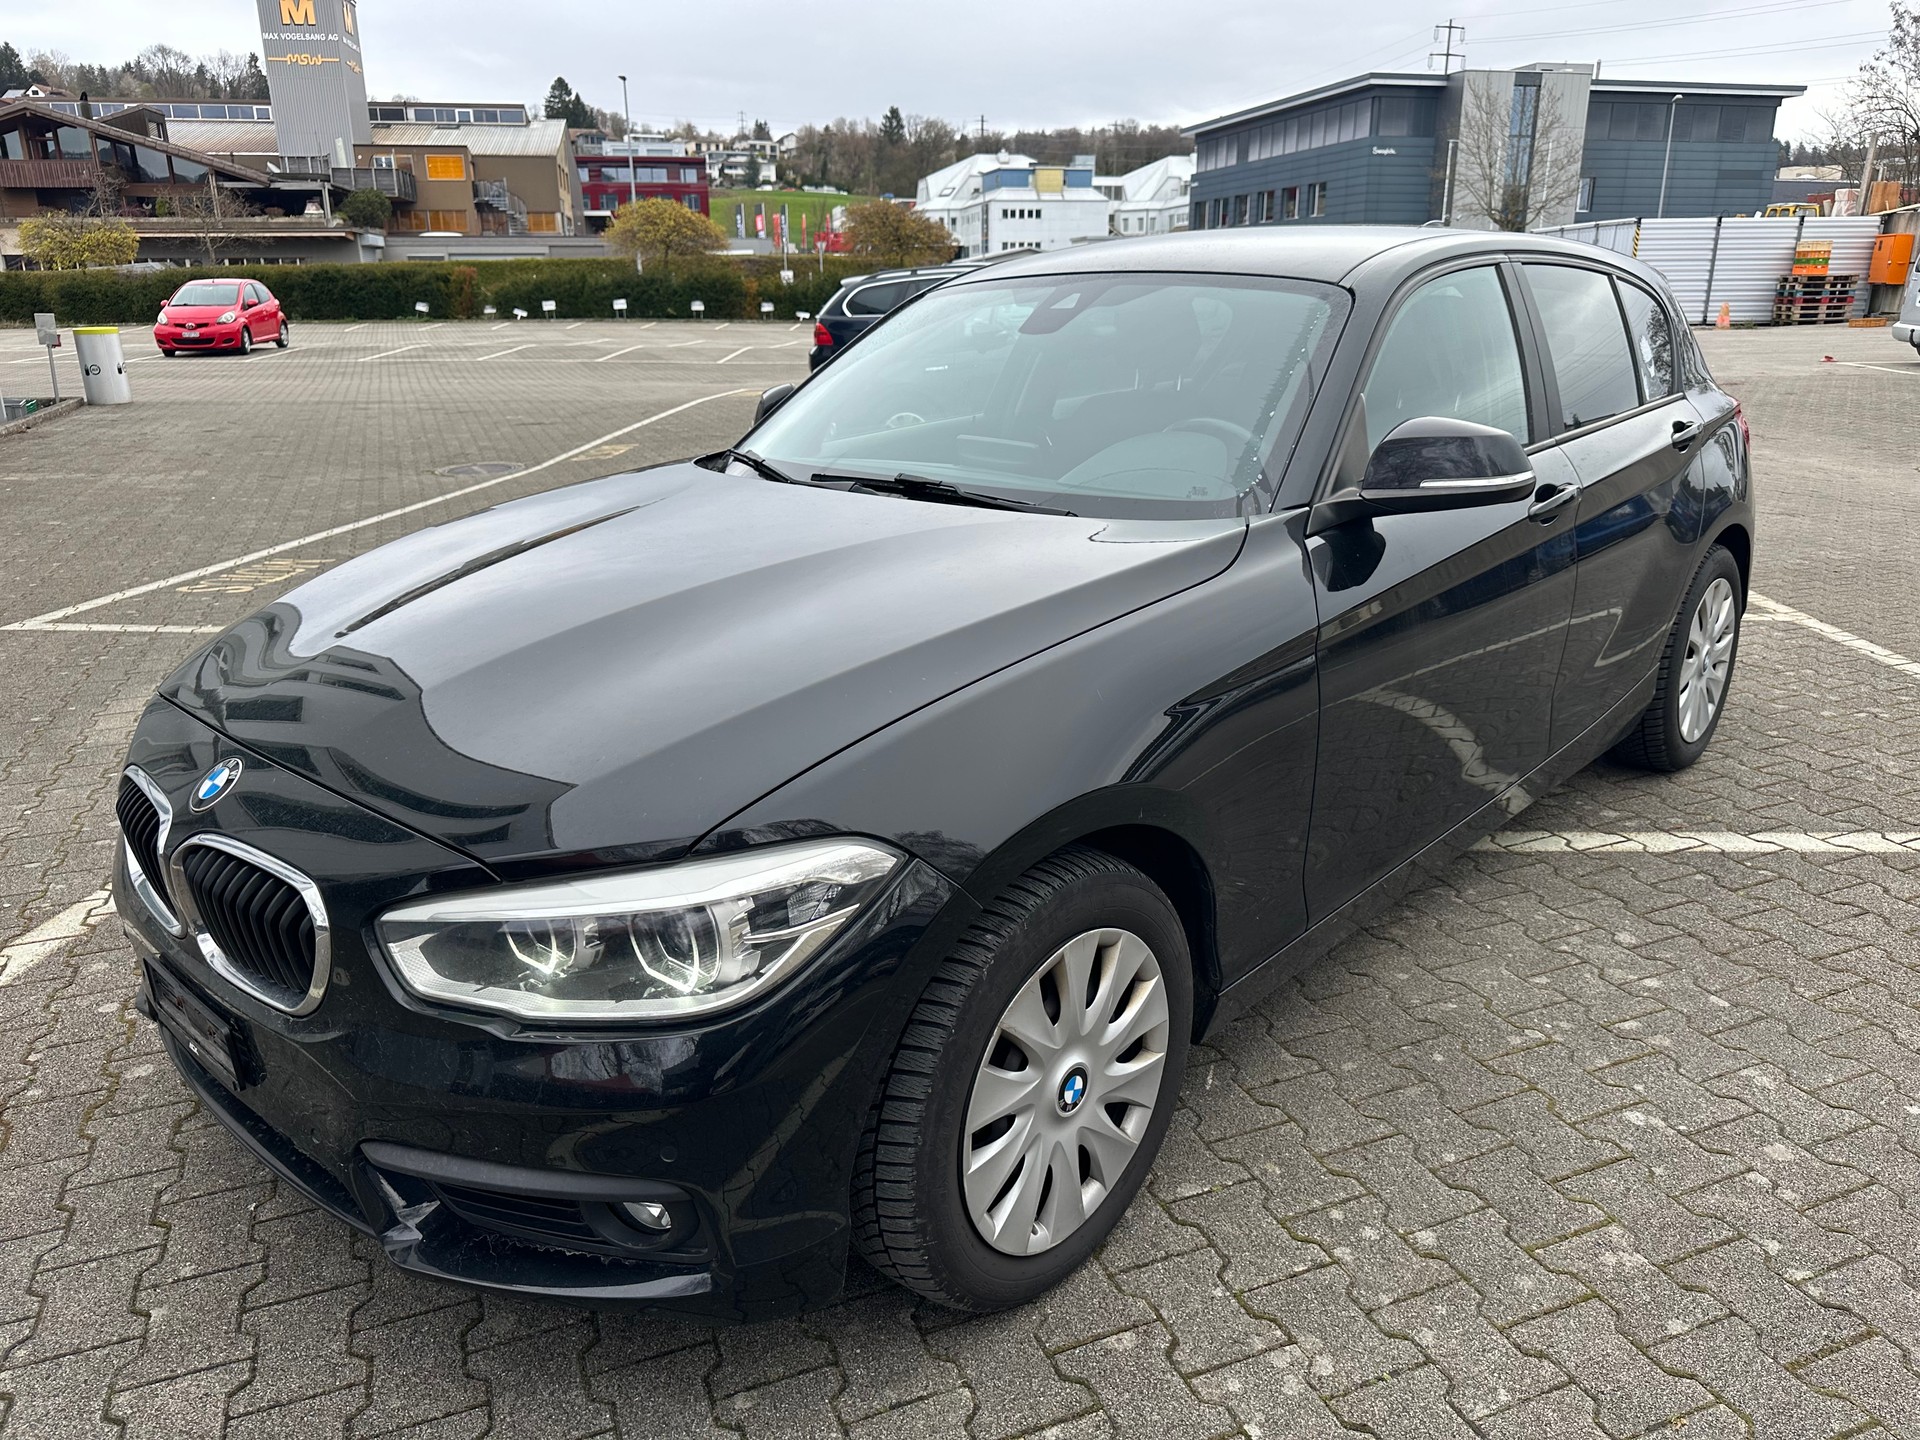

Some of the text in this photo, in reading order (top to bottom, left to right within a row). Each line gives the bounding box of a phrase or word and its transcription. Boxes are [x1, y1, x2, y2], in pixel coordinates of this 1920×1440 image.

[262, 32, 339, 41] MAX VOGELSANG AG
